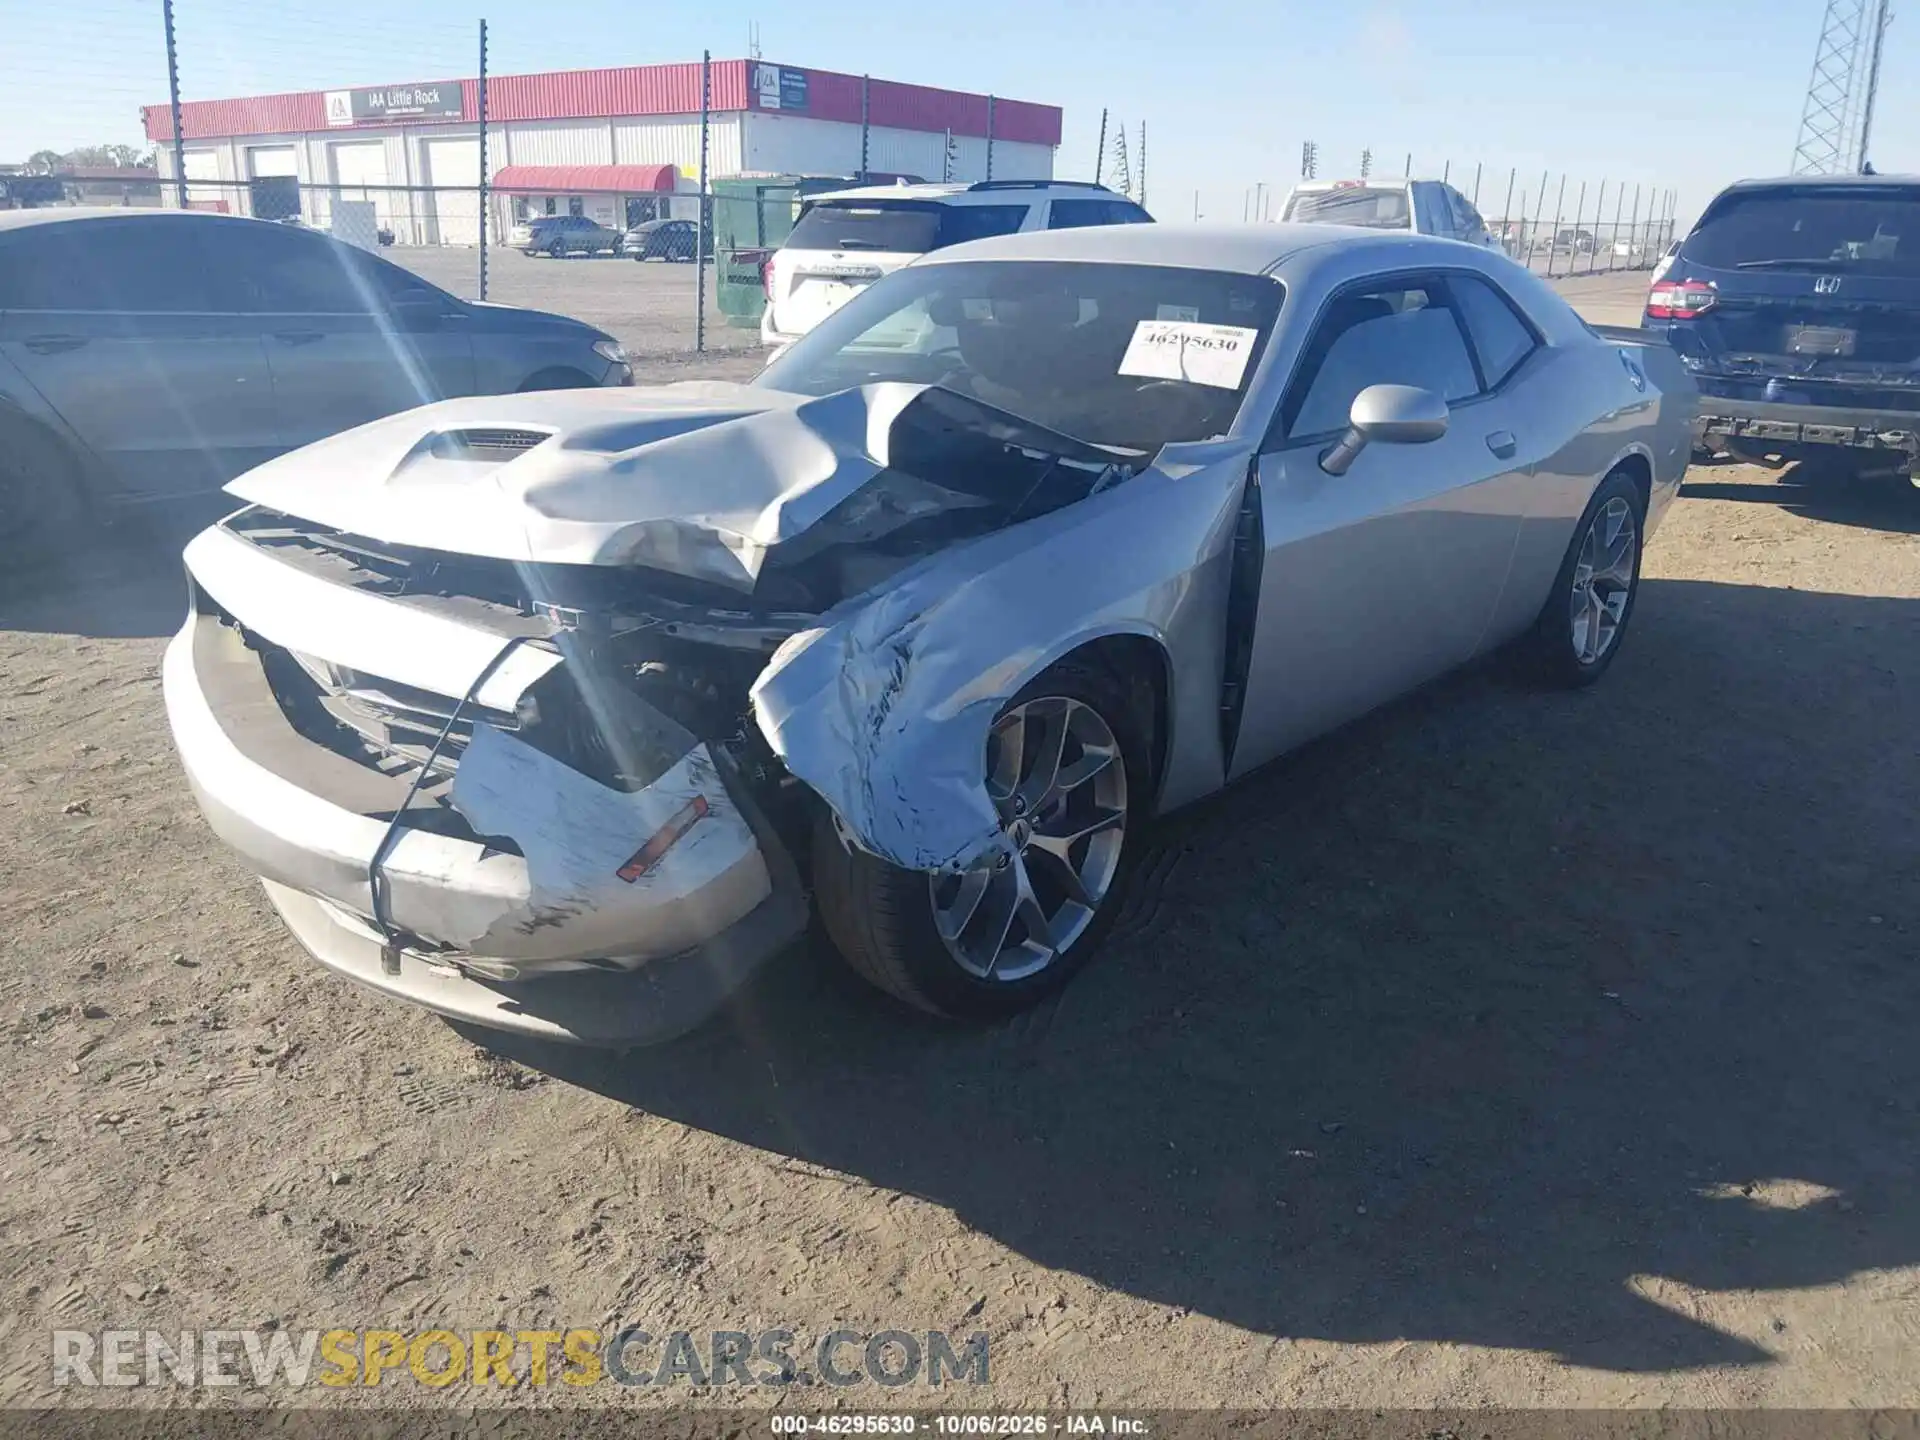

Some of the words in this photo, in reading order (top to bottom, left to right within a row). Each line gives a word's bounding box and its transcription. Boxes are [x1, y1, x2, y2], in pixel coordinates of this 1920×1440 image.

[369, 92, 385, 108] IAA
[387, 89, 412, 107] Little
[415, 88, 440, 105] Rock
[1145, 332, 1238, 352] 46295630
